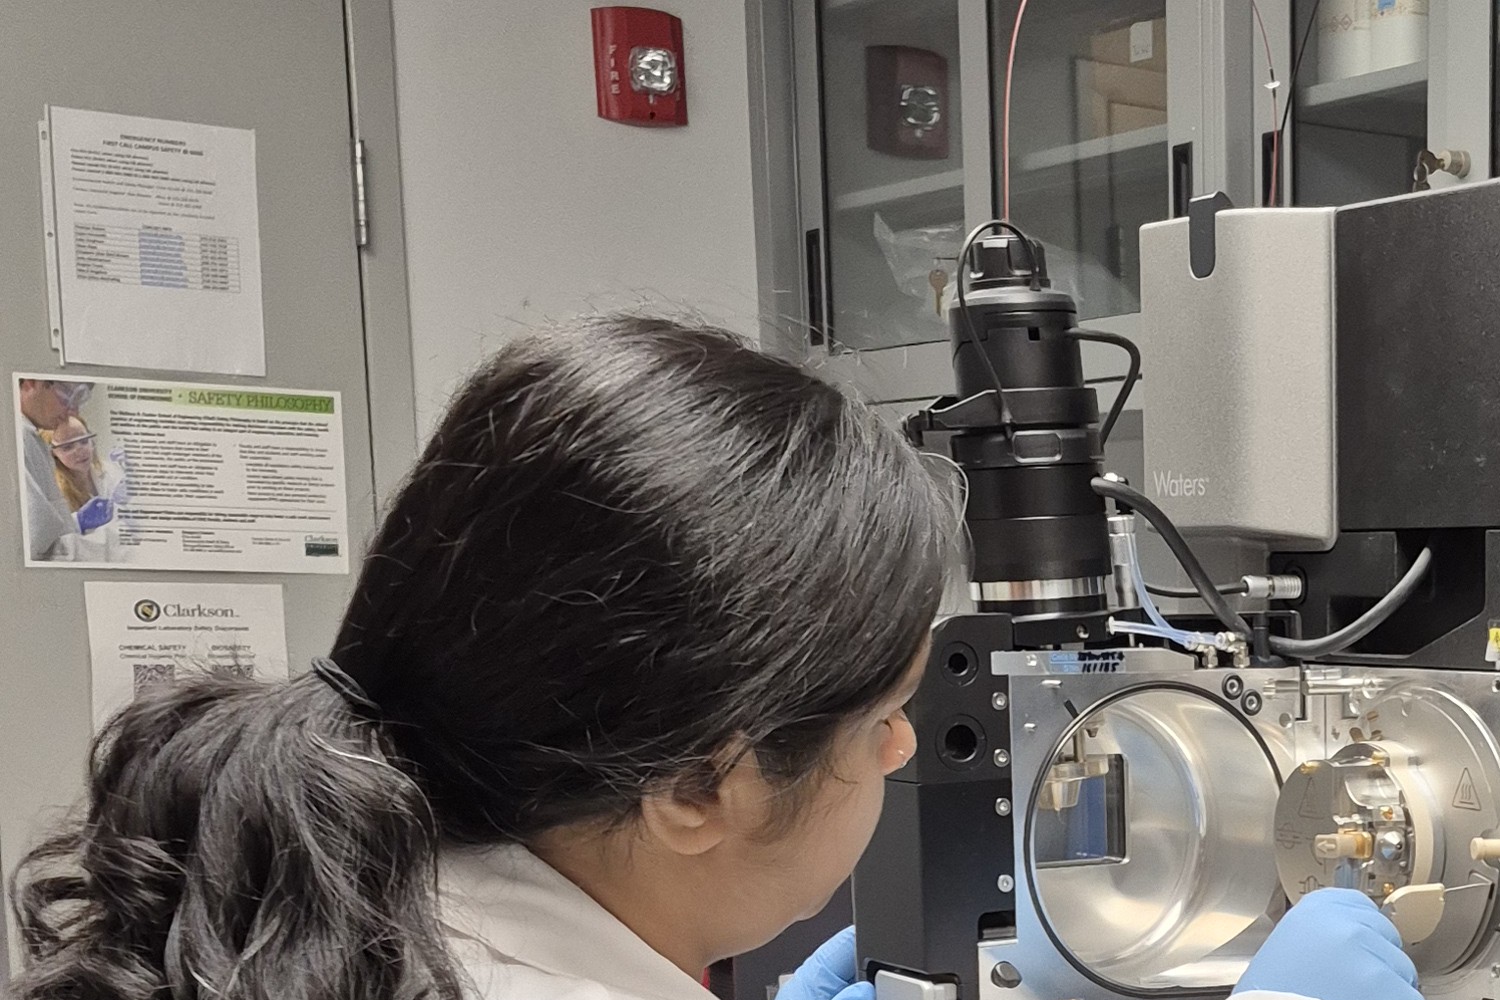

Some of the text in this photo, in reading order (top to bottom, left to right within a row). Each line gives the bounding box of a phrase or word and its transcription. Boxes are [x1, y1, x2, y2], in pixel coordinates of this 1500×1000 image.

[608, 44, 620, 95] FIRE
[188, 391, 332, 413] SAFETY PHILOSOPHY
[1153, 470, 1206, 497] Waters
[163, 603, 234, 618] Clarkson
